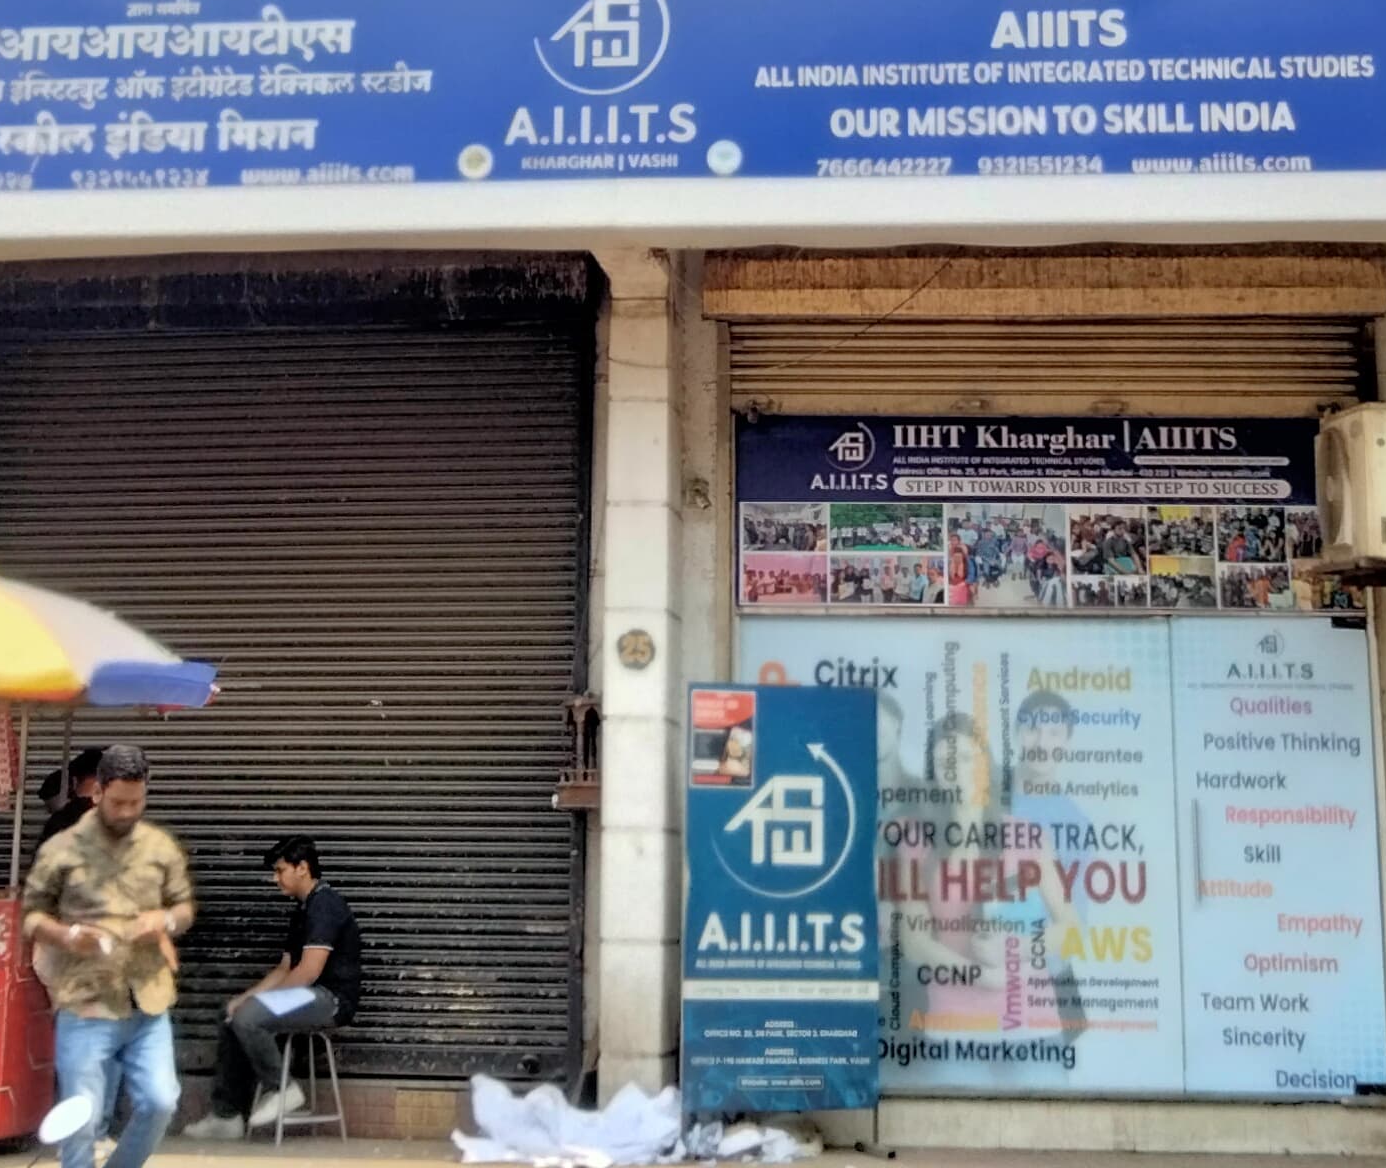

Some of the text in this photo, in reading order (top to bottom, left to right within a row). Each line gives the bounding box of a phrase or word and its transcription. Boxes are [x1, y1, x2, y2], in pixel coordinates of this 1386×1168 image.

[991, 9, 1127, 48] AIIITS
[115, 70, 166, 100] ऑफ
[361, 60, 433, 94] स्टडीज
[755, 55, 1375, 87] ALL INDIA INSTITUTE OF INTEGRATED TECHNICAL STUDIES
[504, 103, 697, 146] A.I.I.I.T.S
[830, 101, 1296, 138] OUR MISSION TO SKILL INDIA
[104, 110, 208, 160] इंडिया
[217, 108, 319, 153] मिशन
[521, 153, 678, 170] KHARGHAR VASHI
[817, 157, 952, 177] 7666442227
[978, 155, 1103, 175] 9321551234
[893, 424, 1237, 455] IIHT Kharghar AIIITS
[906, 480, 1278, 496] STEP IN TOWARDS YOUR FIRST STEP TO SUCCESS
[814, 657, 899, 689] Citrix
[1027, 664, 1131, 691] Android
[943, 641, 960, 781] Cloud Computing
[1230, 696, 1313, 717] Qualities
[1020, 746, 1143, 763] Job Guarantee
[1203, 732, 1361, 757] Positive Thinking
[1023, 780, 1139, 800] Data Analytics
[1196, 771, 1287, 790] Hardwork
[1225, 806, 1357, 830] Responsibility
[945, 822, 1144, 855] CAREER TRACK,
[1244, 845, 1281, 864] Skill
[940, 859, 1041, 903] HELP
[1054, 860, 1147, 904] YOU
[1199, 880, 1274, 898] Attitude
[698, 912, 865, 953] A.I.I.I.T.S
[906, 915, 1025, 933] Virtualization
[1277, 913, 1363, 938] Empathy
[1031, 919, 1046, 970] CCNA
[1060, 926, 1154, 964] AWS
[917, 965, 982, 987] CCNP
[1244, 953, 1339, 978] Optimism
[1003, 937, 1022, 1031] Vmware
[890, 992, 901, 1031] Cloud
[1072, 996, 1159, 1012] Management
[1201, 992, 1310, 1013] Team Work
[1223, 1028, 1306, 1053] Sincerity
[956, 1040, 1076, 1070] Marketing
[1276, 1070, 1358, 1090] Decision
